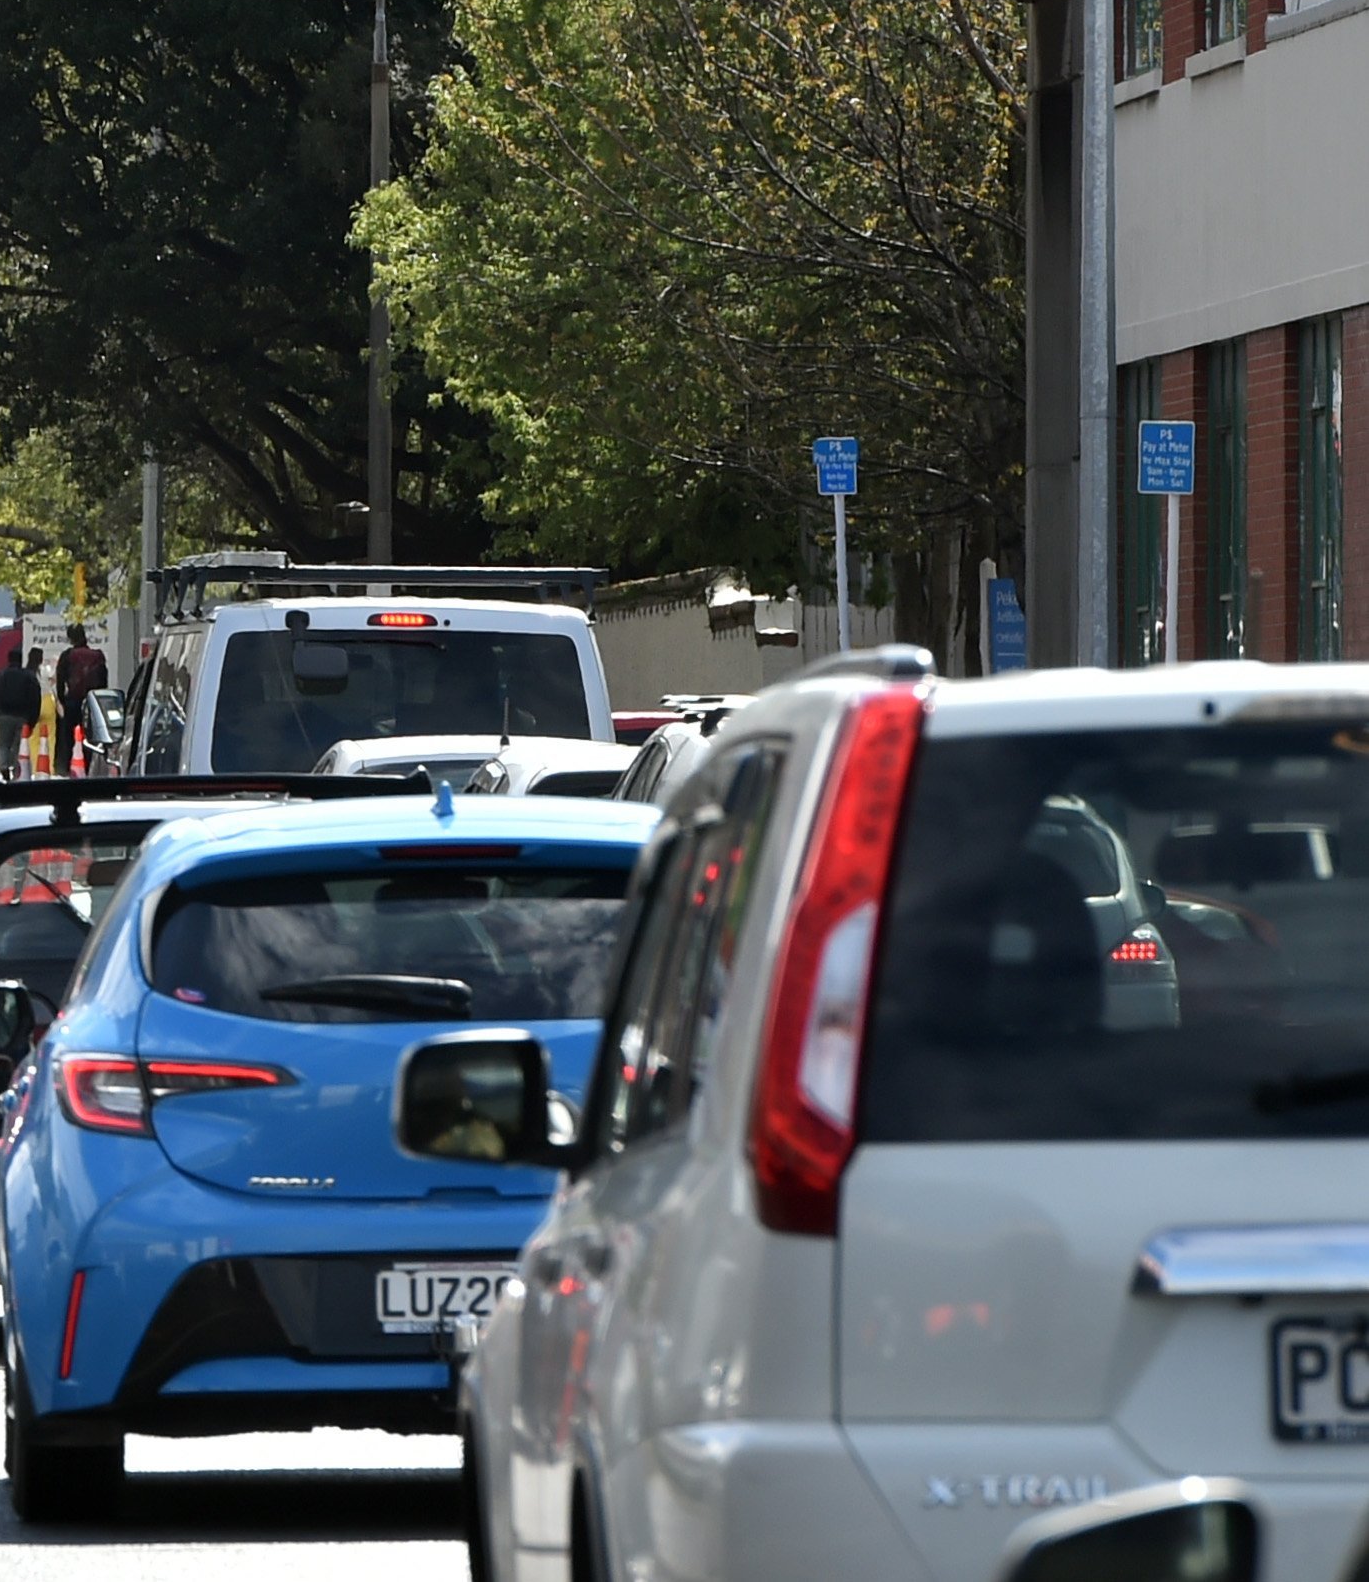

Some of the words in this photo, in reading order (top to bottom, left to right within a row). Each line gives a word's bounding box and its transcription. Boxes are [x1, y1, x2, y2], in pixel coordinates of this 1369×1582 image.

[1142, 441, 1157, 455] Pay
[1158, 442, 1167, 453] at
[1168, 442, 1190, 454] Meter
[381, 1276, 511, 1317] LUZ2
